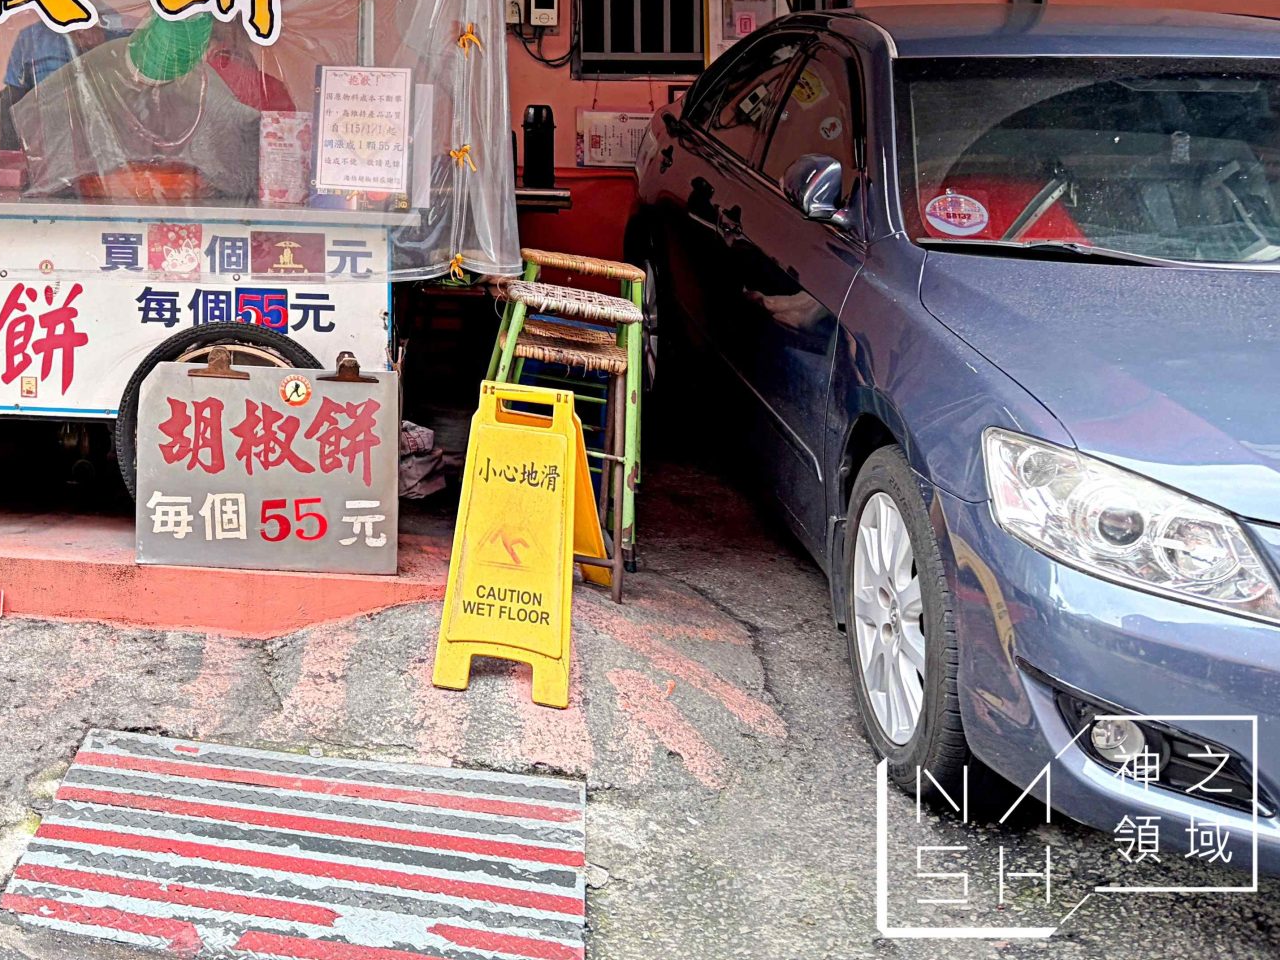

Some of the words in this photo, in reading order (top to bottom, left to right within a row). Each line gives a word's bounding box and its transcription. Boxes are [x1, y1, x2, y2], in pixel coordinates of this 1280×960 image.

[157, 394, 383, 489] 胡椒餅
[477, 456, 562, 493] 小心地滑
[475, 584, 543, 607] CAUTION
[462, 600, 496, 619] WET
[498, 603, 551, 627] FLOOR
